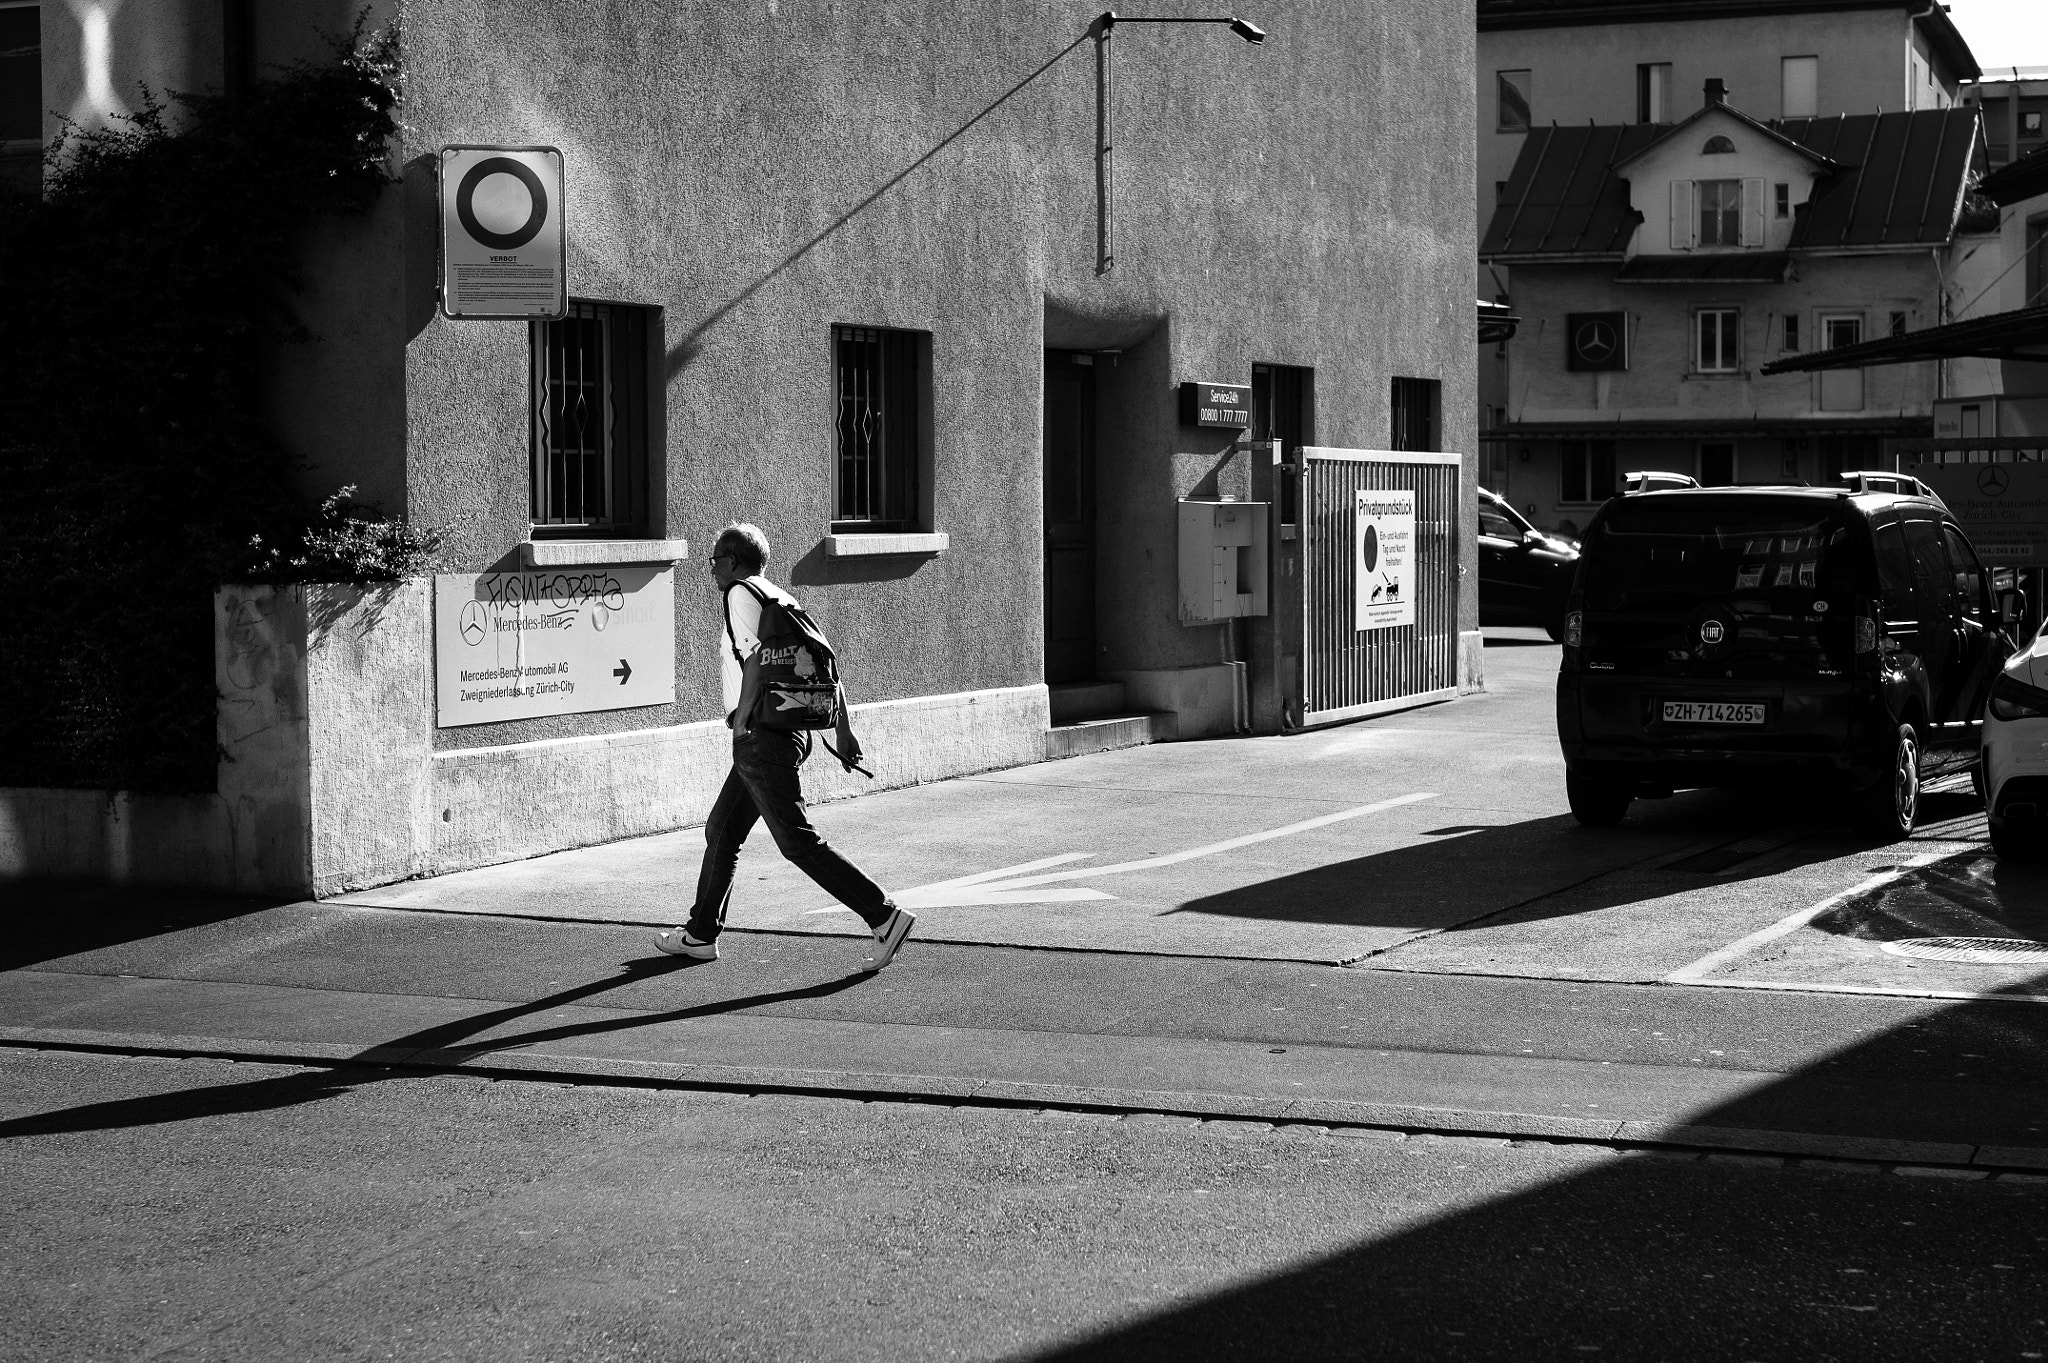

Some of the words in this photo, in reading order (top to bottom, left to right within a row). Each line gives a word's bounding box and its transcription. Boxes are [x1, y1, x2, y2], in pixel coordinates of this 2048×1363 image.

[1358, 498, 1413, 520] Privatgrundstück
[1945, 499, 1993, 509] des-Benz
[493, 612, 563, 633] Mercedes-Benz
[1706, 627, 1720, 638] FIAT
[460, 667, 519, 682] Mercedes-Benz
[557, 661, 569, 674] AG
[460, 684, 535, 703] Zweigniederlassung
[535, 680, 576, 696] Zürich-City
